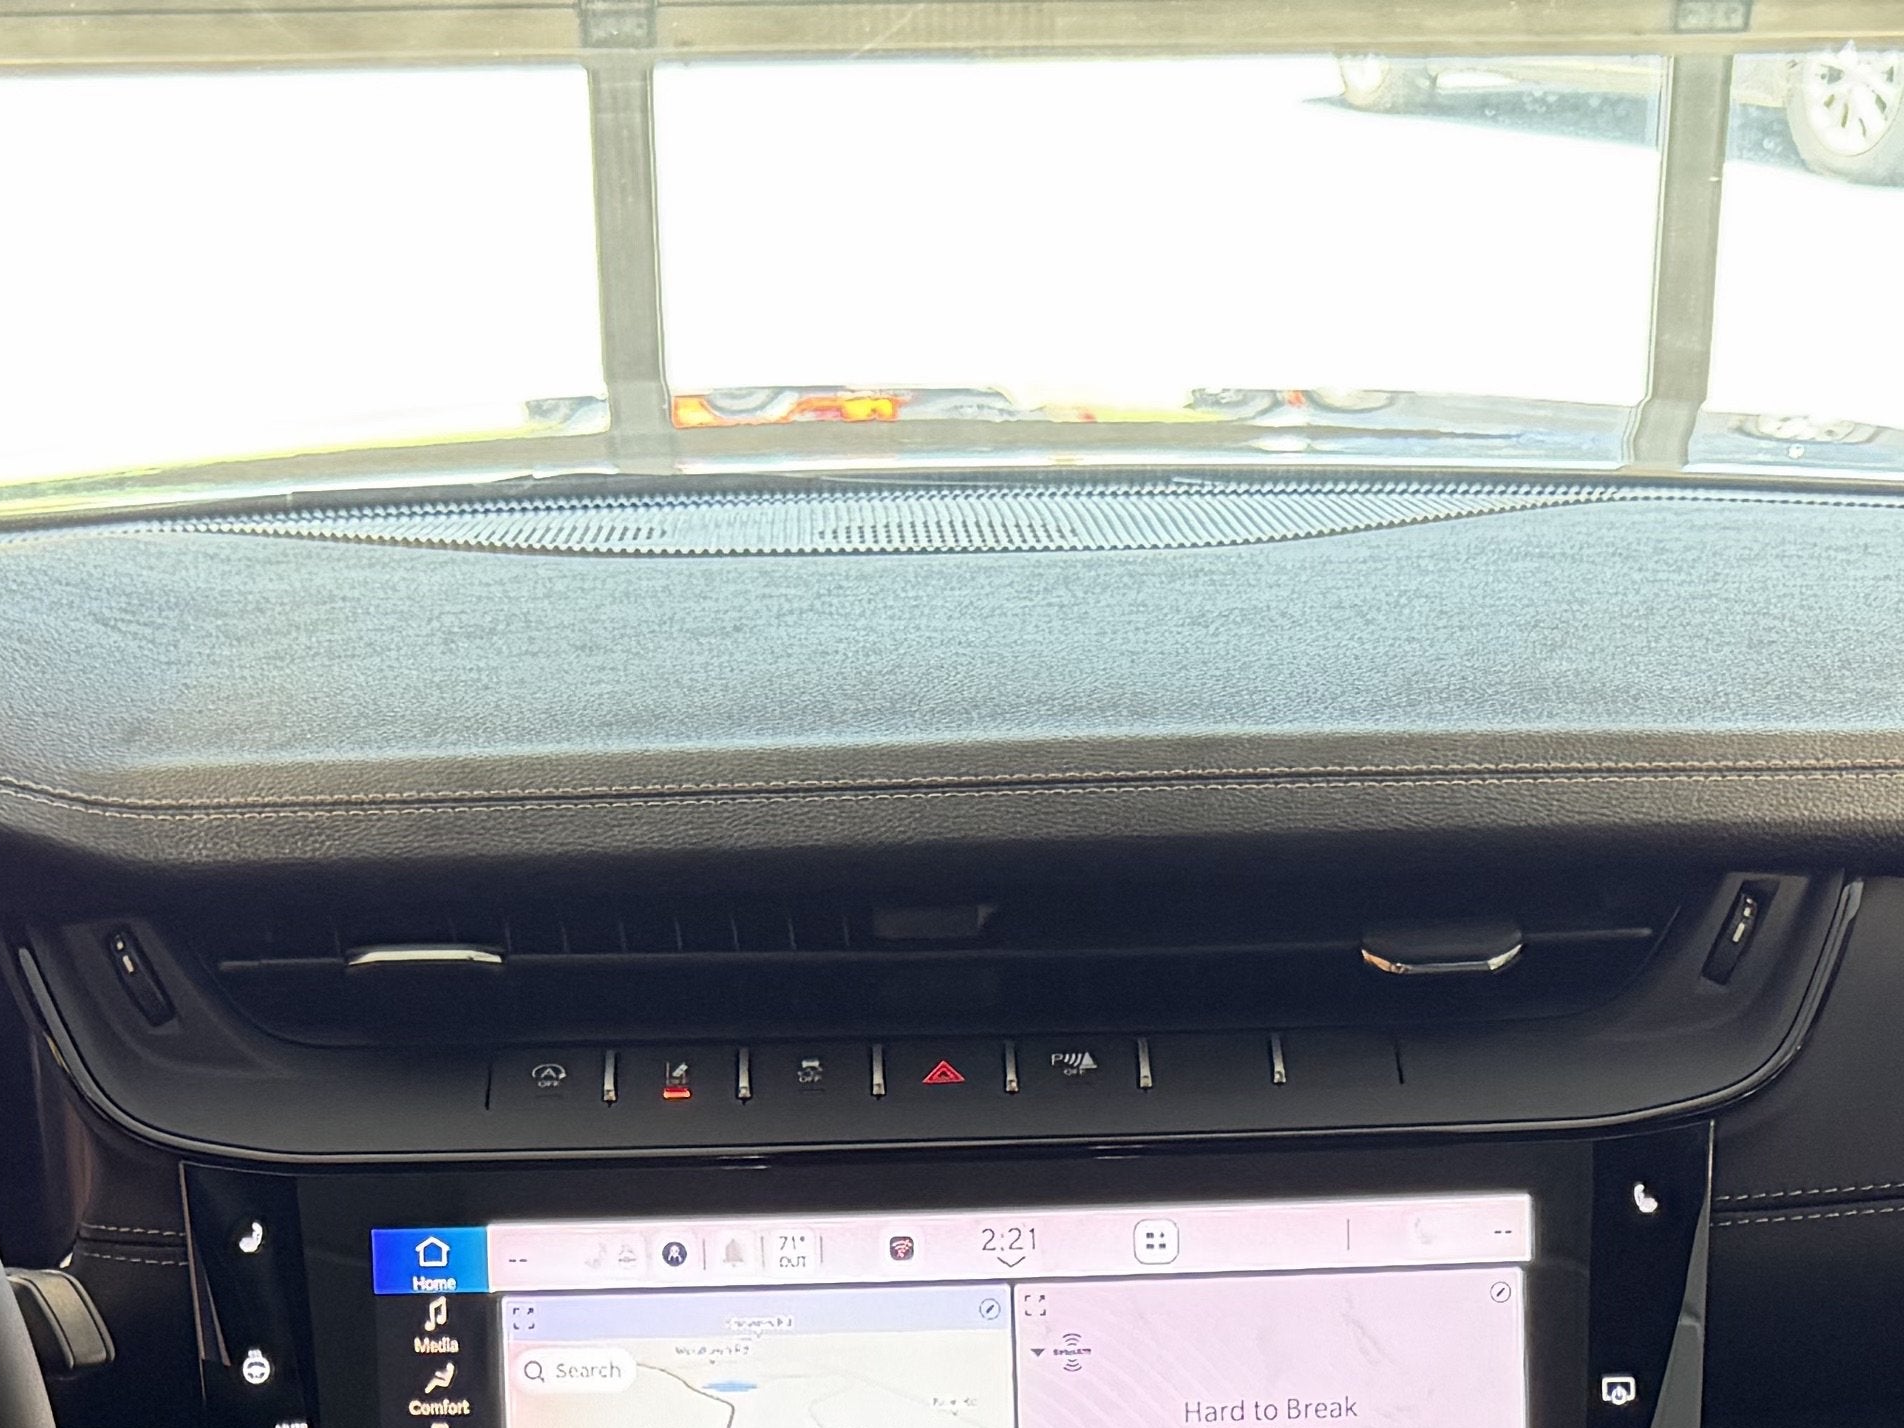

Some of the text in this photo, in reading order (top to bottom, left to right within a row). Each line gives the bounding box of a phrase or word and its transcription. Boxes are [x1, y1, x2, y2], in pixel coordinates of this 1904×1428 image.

[981, 1227, 1037, 1252] 2:21
[778, 1255, 807, 1269] OUT
[412, 1276, 457, 1291] Home
[413, 1336, 459, 1353] Media
[555, 1360, 622, 1379] Search
[409, 1398, 469, 1417] Comfort
[1183, 1396, 1358, 1424] Hard to Break
